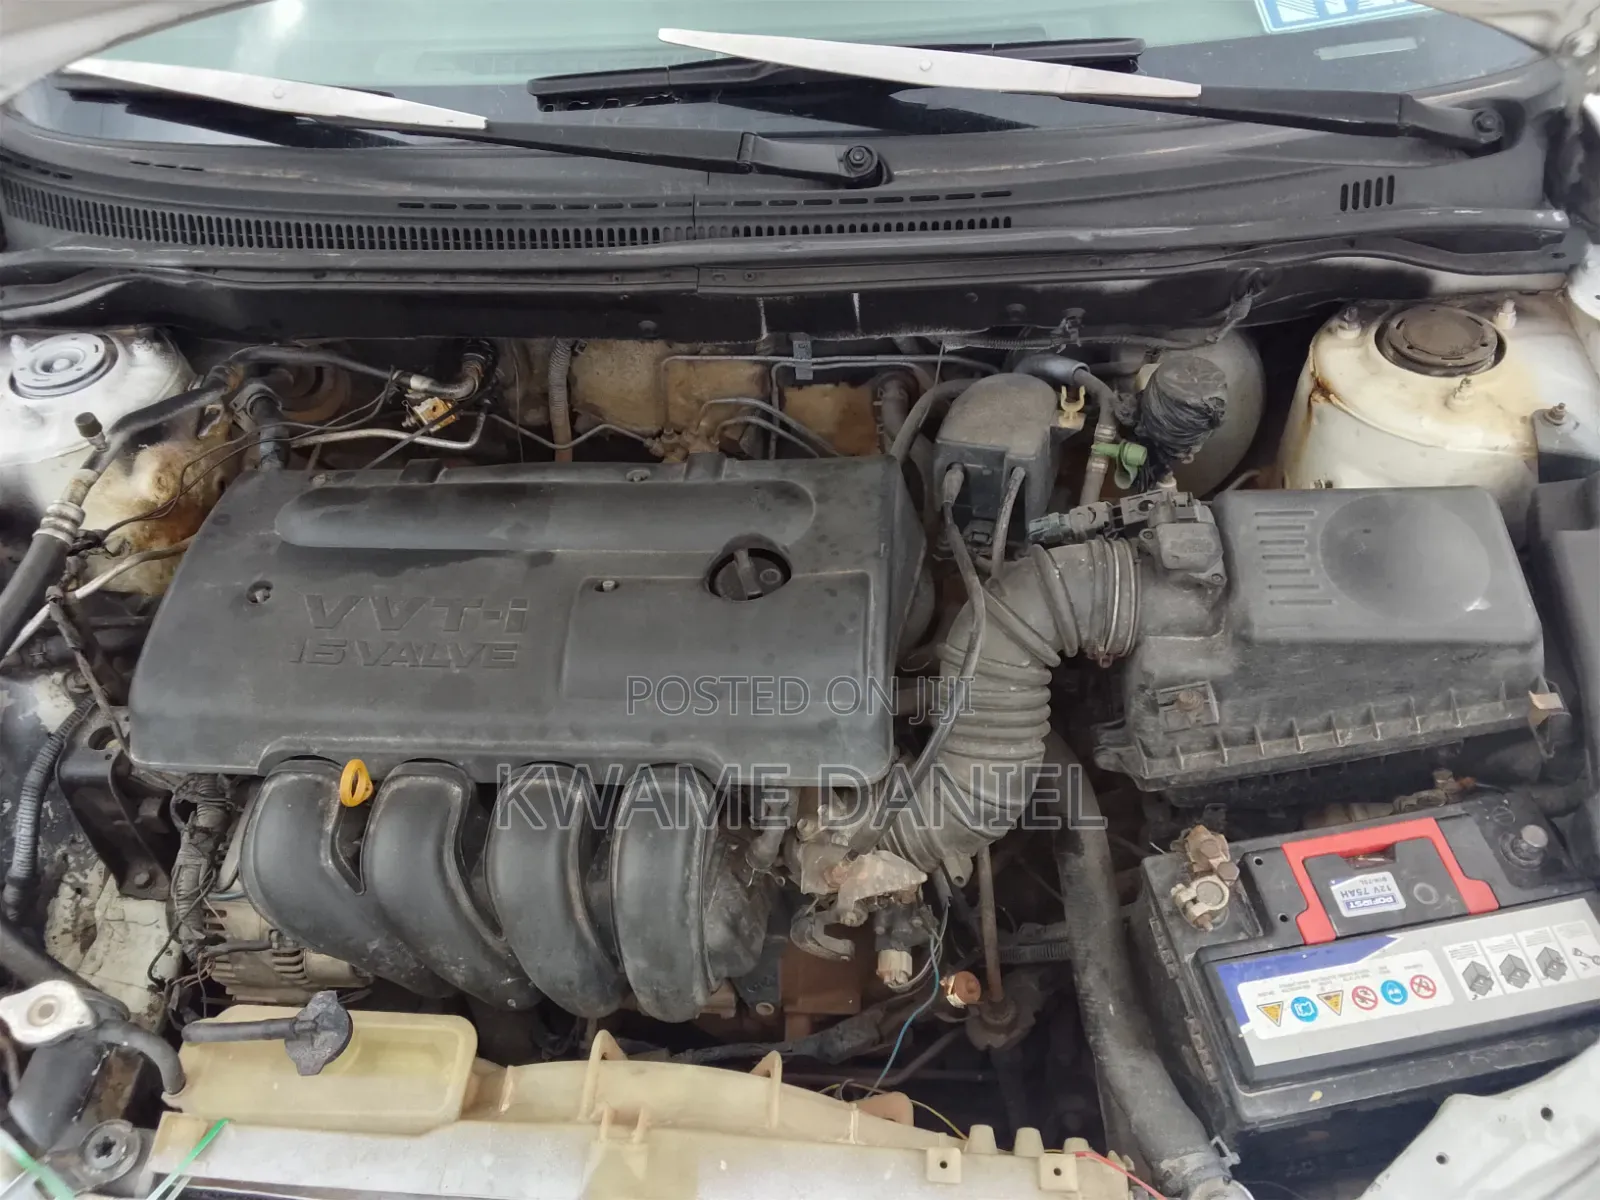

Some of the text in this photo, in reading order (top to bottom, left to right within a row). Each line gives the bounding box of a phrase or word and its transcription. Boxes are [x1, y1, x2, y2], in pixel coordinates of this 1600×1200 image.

[304, 594, 529, 634] VVT-i
[1340, 884, 1392, 898] 12V 75AH
